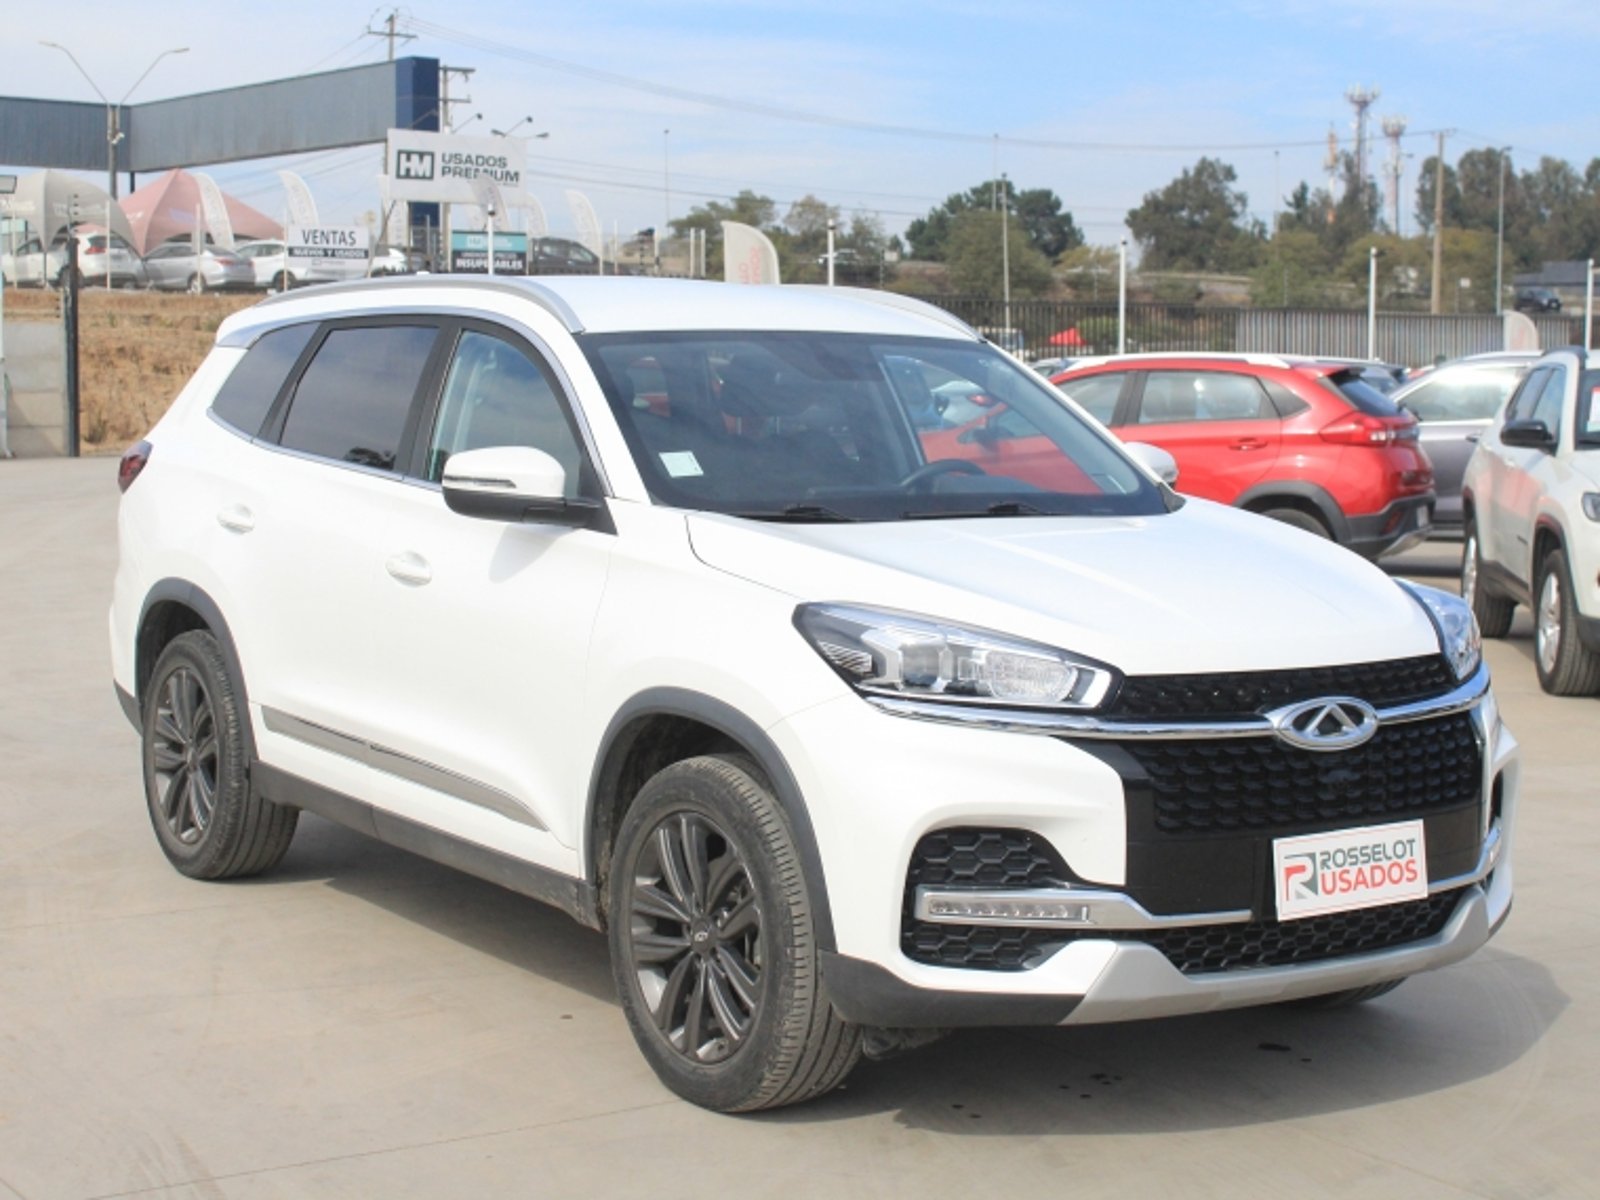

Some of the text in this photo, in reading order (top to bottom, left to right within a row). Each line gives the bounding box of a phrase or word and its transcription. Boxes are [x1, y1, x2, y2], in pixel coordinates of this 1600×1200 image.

[397, 151, 433, 179] HM
[441, 152, 507, 169] USADOS
[302, 229, 357, 247] VENTAS
[456, 258, 523, 269] INSUPEABLES
[1320, 839, 1416, 870] ROSSELOT
[1321, 859, 1418, 895] USADOS
